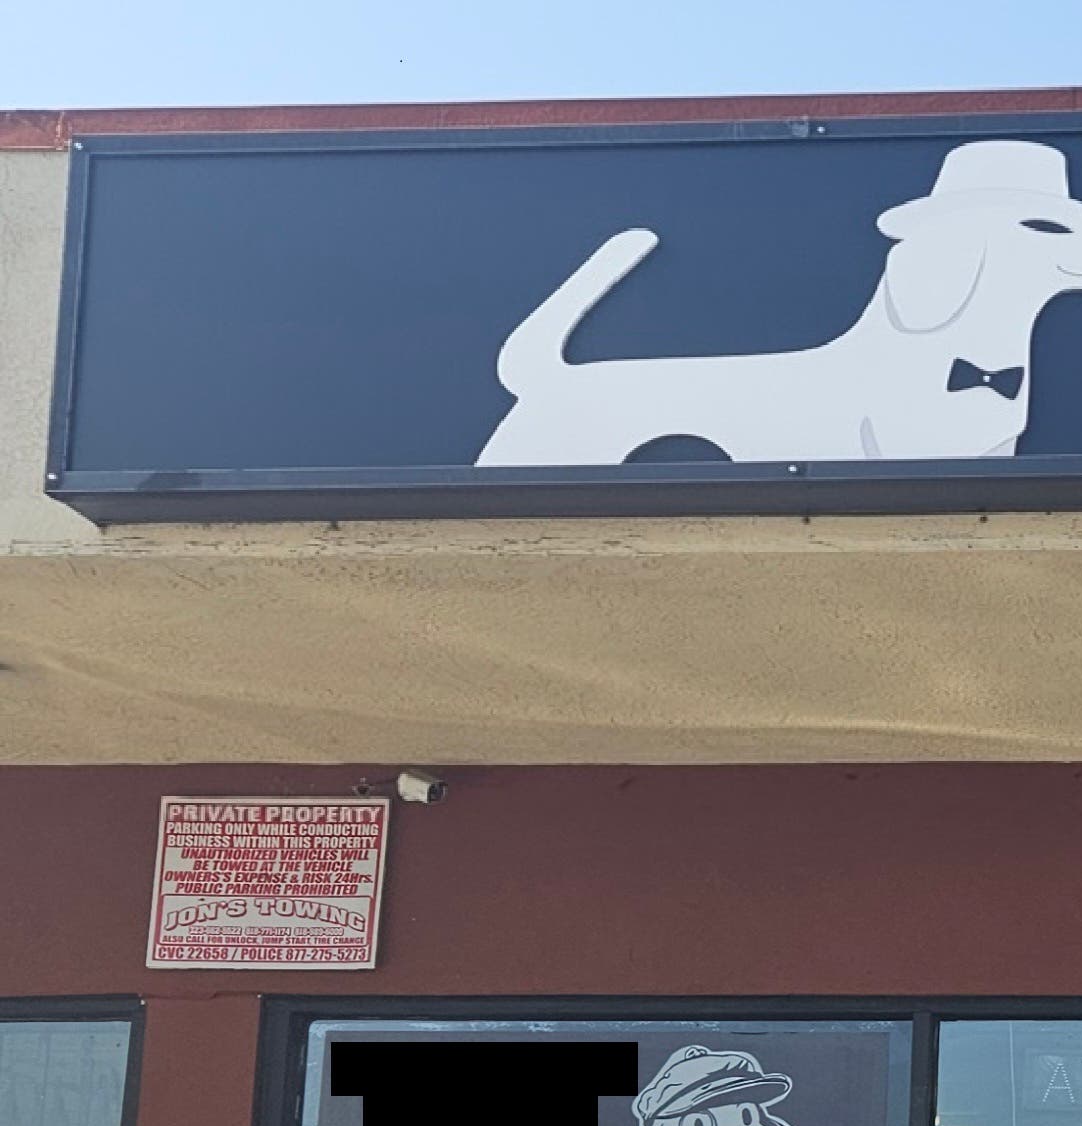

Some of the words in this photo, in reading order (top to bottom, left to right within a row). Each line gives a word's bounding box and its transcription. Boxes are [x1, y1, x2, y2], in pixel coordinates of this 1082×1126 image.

[169, 804, 260, 822] PRIVATE
[265, 806, 381, 823] PROPERTY
[166, 822, 222, 835] PARKING
[225, 823, 254, 835] ONLY
[258, 824, 296, 836] WHILE
[299, 824, 379, 836] CONDUCTING
[167, 835, 231, 848] BUSINESS
[233, 836, 280, 848] WITHIN
[283, 837, 311, 848] THIS
[314, 837, 376, 848] PROPERTY
[181, 848, 278, 860] UNAUTHORIZED
[281, 849, 338, 861] VEHICLES
[340, 849, 370, 861] WILL
[193, 860, 210, 871] BE
[213, 860, 258, 871] TOWED
[259, 861, 276, 872] AT
[279, 861, 301, 872] THE
[304, 861, 354, 872] VEHICLE
[234, 872, 289, 884] EXPENSE
[302, 873, 333, 884] RISK
[175, 882, 223, 894] PUBLIC
[225, 883, 282, 895] PARKING
[283, 884, 359, 895] PROHIBITED
[164, 899, 247, 931] JON'S
[254, 898, 366, 932] TOWING
[158, 947, 184, 958] CVC
[187, 947, 229, 959] 22658
[231, 947, 237, 960] /
[240, 948, 283, 960] POLICE
